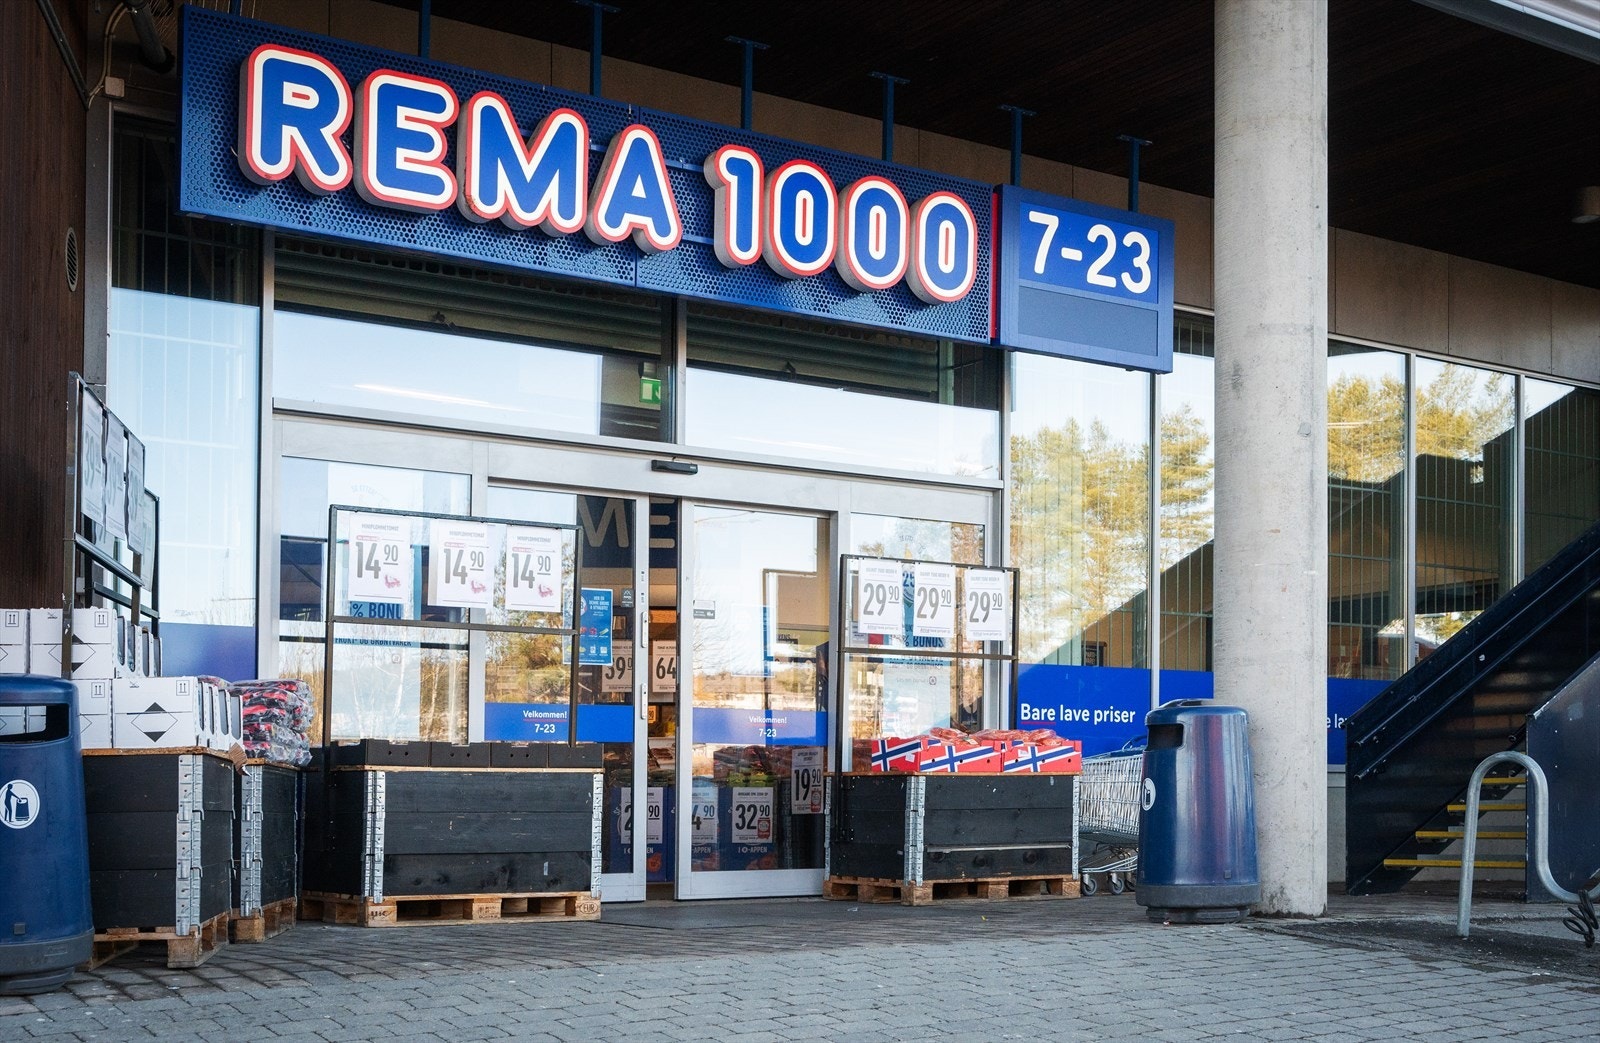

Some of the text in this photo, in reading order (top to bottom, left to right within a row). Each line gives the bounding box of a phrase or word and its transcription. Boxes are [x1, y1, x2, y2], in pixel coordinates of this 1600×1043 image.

[243, 43, 978, 303] REMA 1000
[1028, 210, 1152, 294] 7-23
[355, 541, 399, 579] 14 90
[443, 548, 485, 585] 14 90
[511, 553, 552, 589] 14 90
[863, 582, 900, 617] 29 90
[916, 586, 952, 620] 29 90
[969, 591, 1003, 623] 29 90
[655, 657, 677, 680] 64
[522, 710, 567, 719] Velkommen!
[534, 723, 556, 734] 7-23
[748, 716, 788, 724] Velkommen!
[1020, 703, 1136, 726] Bare lave priser
[759, 728, 777, 738] 7-23
[794, 768, 811, 801] 19
[811, 768, 821, 784] 90
[648, 805, 660, 818] 90
[703, 804, 715, 818] 90
[735, 803, 757, 831] 32
[759, 804, 770, 817] 90
[583, 903, 595, 913] EUR
